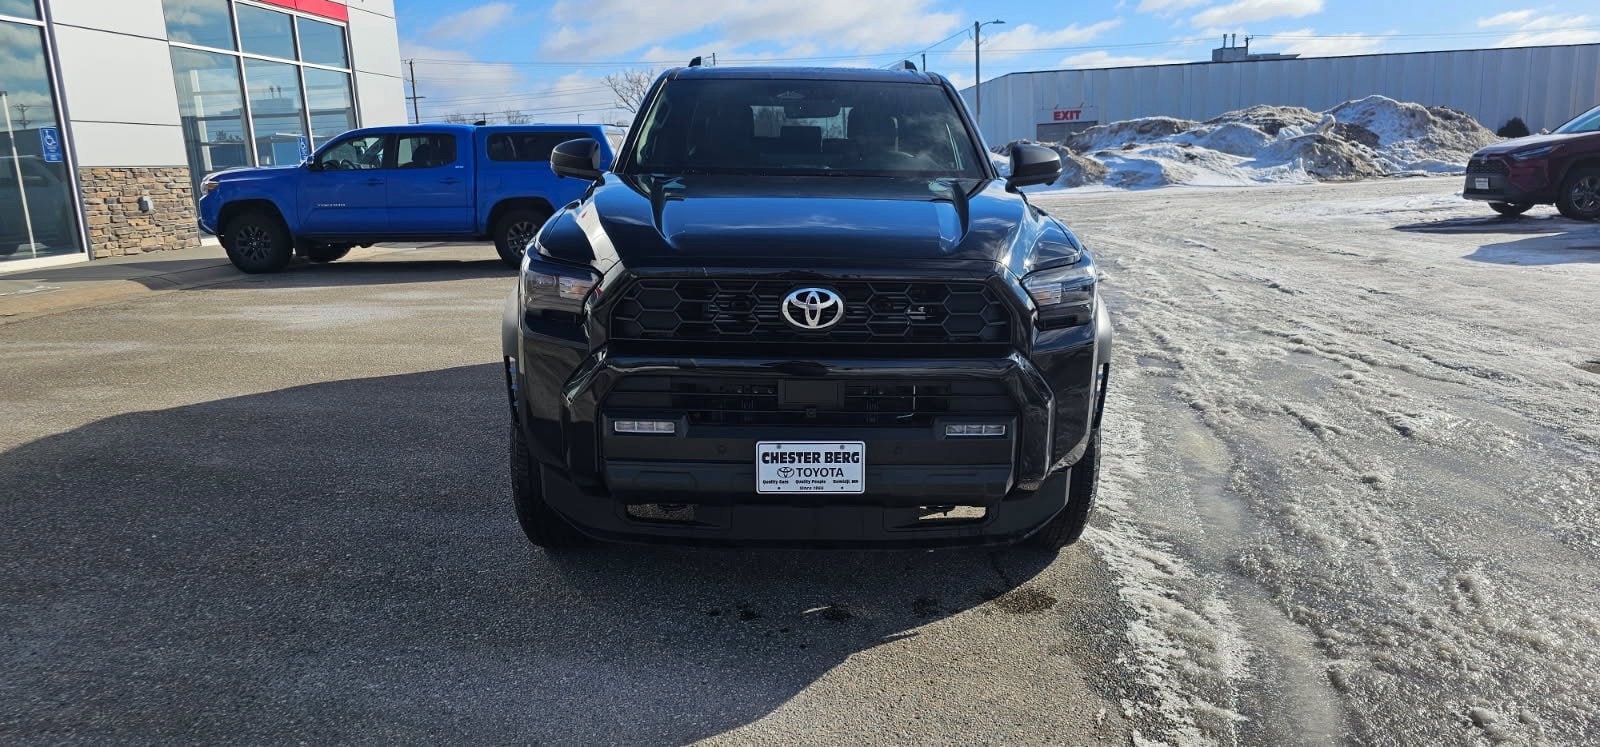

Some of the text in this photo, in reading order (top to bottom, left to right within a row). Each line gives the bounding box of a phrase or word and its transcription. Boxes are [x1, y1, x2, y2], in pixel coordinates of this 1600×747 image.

[1053, 110, 1082, 121] EXIT
[762, 451, 860, 464] CHESTER BERG
[796, 467, 844, 478] TOYOTA
